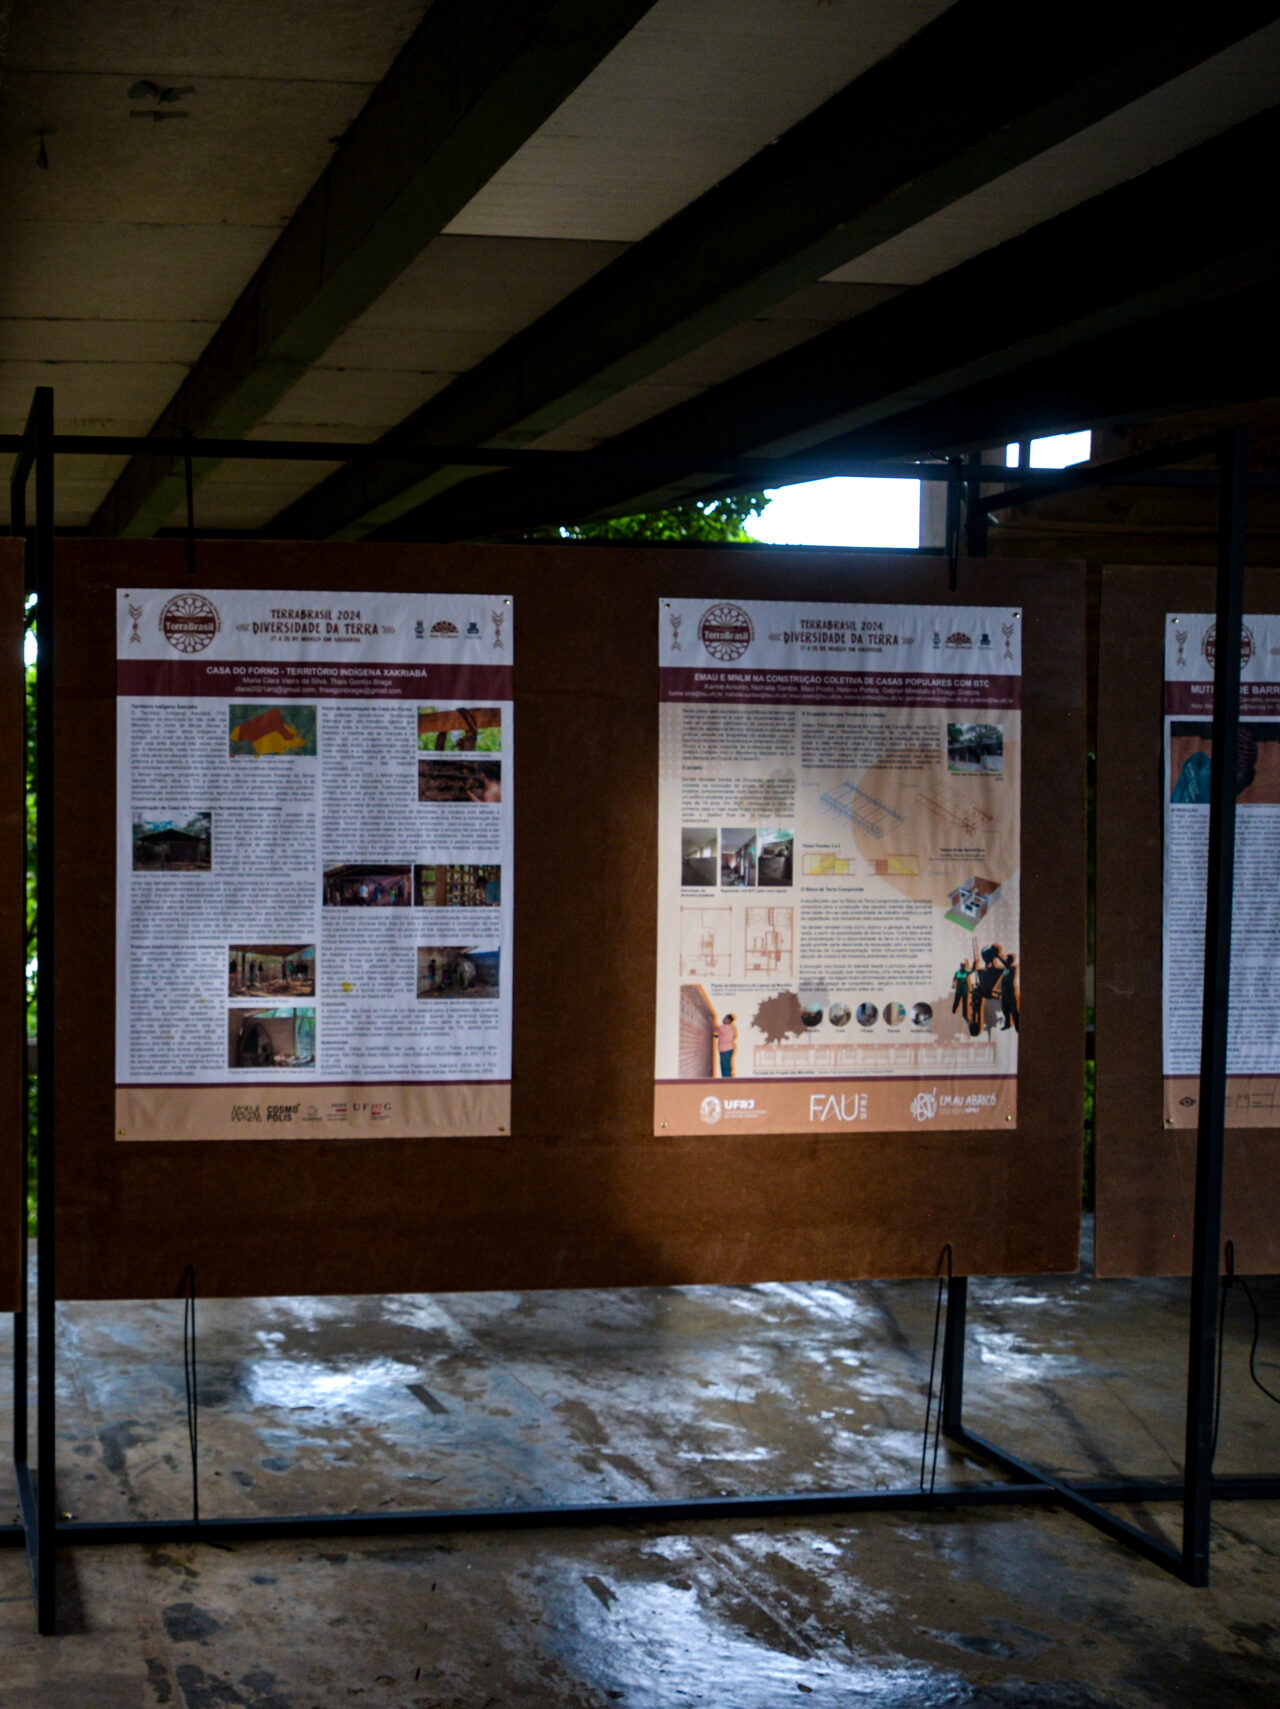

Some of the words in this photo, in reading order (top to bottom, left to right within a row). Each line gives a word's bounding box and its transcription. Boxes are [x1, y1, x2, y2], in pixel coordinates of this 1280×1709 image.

[271, 609, 332, 620] TERRABRASIL
[337, 611, 361, 620] 2024
[166, 622, 214, 631] TerraBrasil
[252, 622, 320, 634] DIVERSIDADE
[327, 623, 340, 634] DA
[345, 623, 378, 635] TERRA
[800, 619, 857, 631] TERRABRASIL
[861, 622, 883, 631] 2024
[704, 631, 749, 641] TerraBrasil
[783, 631, 846, 644] DIVERSIDADE
[851, 633, 863, 644] DA
[868, 634, 899, 645] TERRA
[206, 666, 231, 675] CASA
[233, 666, 247, 675] DO
[248, 666, 279, 675] FORNO
[285, 665, 338, 676] TERRITÓRIO
[340, 666, 381, 677] INDÍGENA
[383, 667, 428, 677] XAKRIABÁ
[694, 673, 719, 682] EMAU
[727, 674, 752, 682] MNLM
[753, 674, 765, 682] NA
[766, 673, 822, 685] CONSTRUÇÃO
[823, 676, 863, 685] COLETIVA
[864, 677, 875, 685] DE
[876, 677, 904, 686] CASAS
[905, 678, 952, 687] POPULARES
[953, 679, 972, 687] COM
[1252, 685, 1280, 695] BARR
[724, 1099, 755, 1109] UFRJ
[940, 1095, 964, 1106] EMAU
[965, 1091, 996, 1106] ABRICÓ
[266, 1105, 298, 1114] COSMO
[810, 1094, 859, 1121] FAU
[267, 1113, 292, 1121] POLIS
